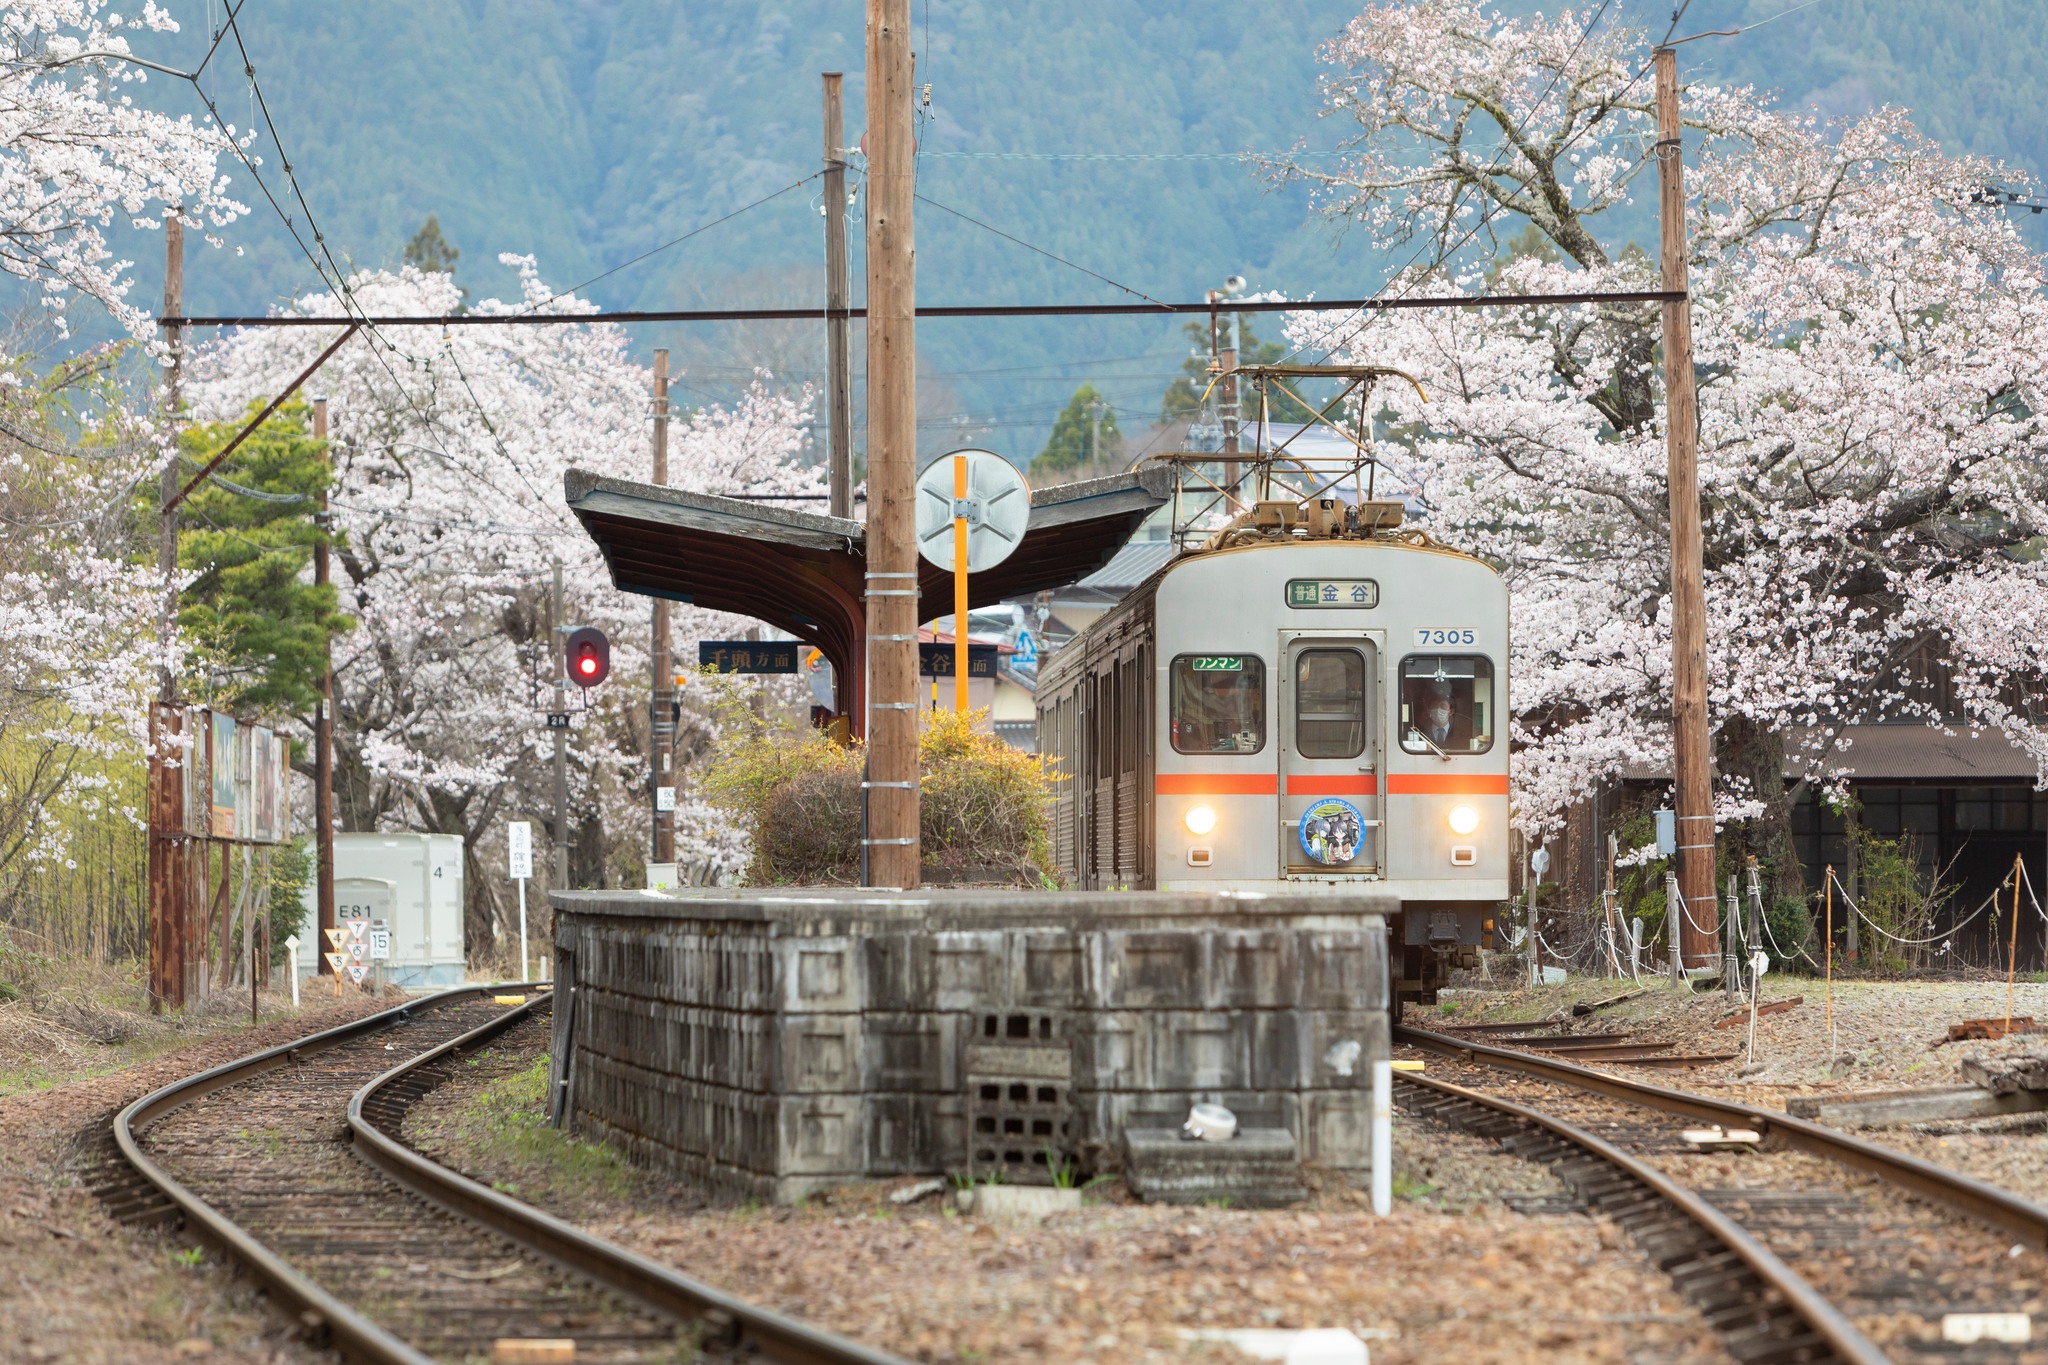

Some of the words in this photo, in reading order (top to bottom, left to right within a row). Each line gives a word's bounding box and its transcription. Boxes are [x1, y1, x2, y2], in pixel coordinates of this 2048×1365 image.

[1295, 585, 1317, 601] 普通
[1321, 584, 1368, 602] 金谷
[1418, 630, 1474, 644] 7305
[709, 648, 790, 669] 千頭方面
[1195, 657, 1240, 668] ワンマン
[551, 716, 566, 726] 2R
[433, 866, 443, 878] 4
[339, 905, 371, 918] E81
[333, 932, 342, 943] 4
[372, 934, 387, 949] 15
[352, 945, 362, 957] 6
[333, 955, 343, 967] 3
[353, 967, 362, 979] 5
